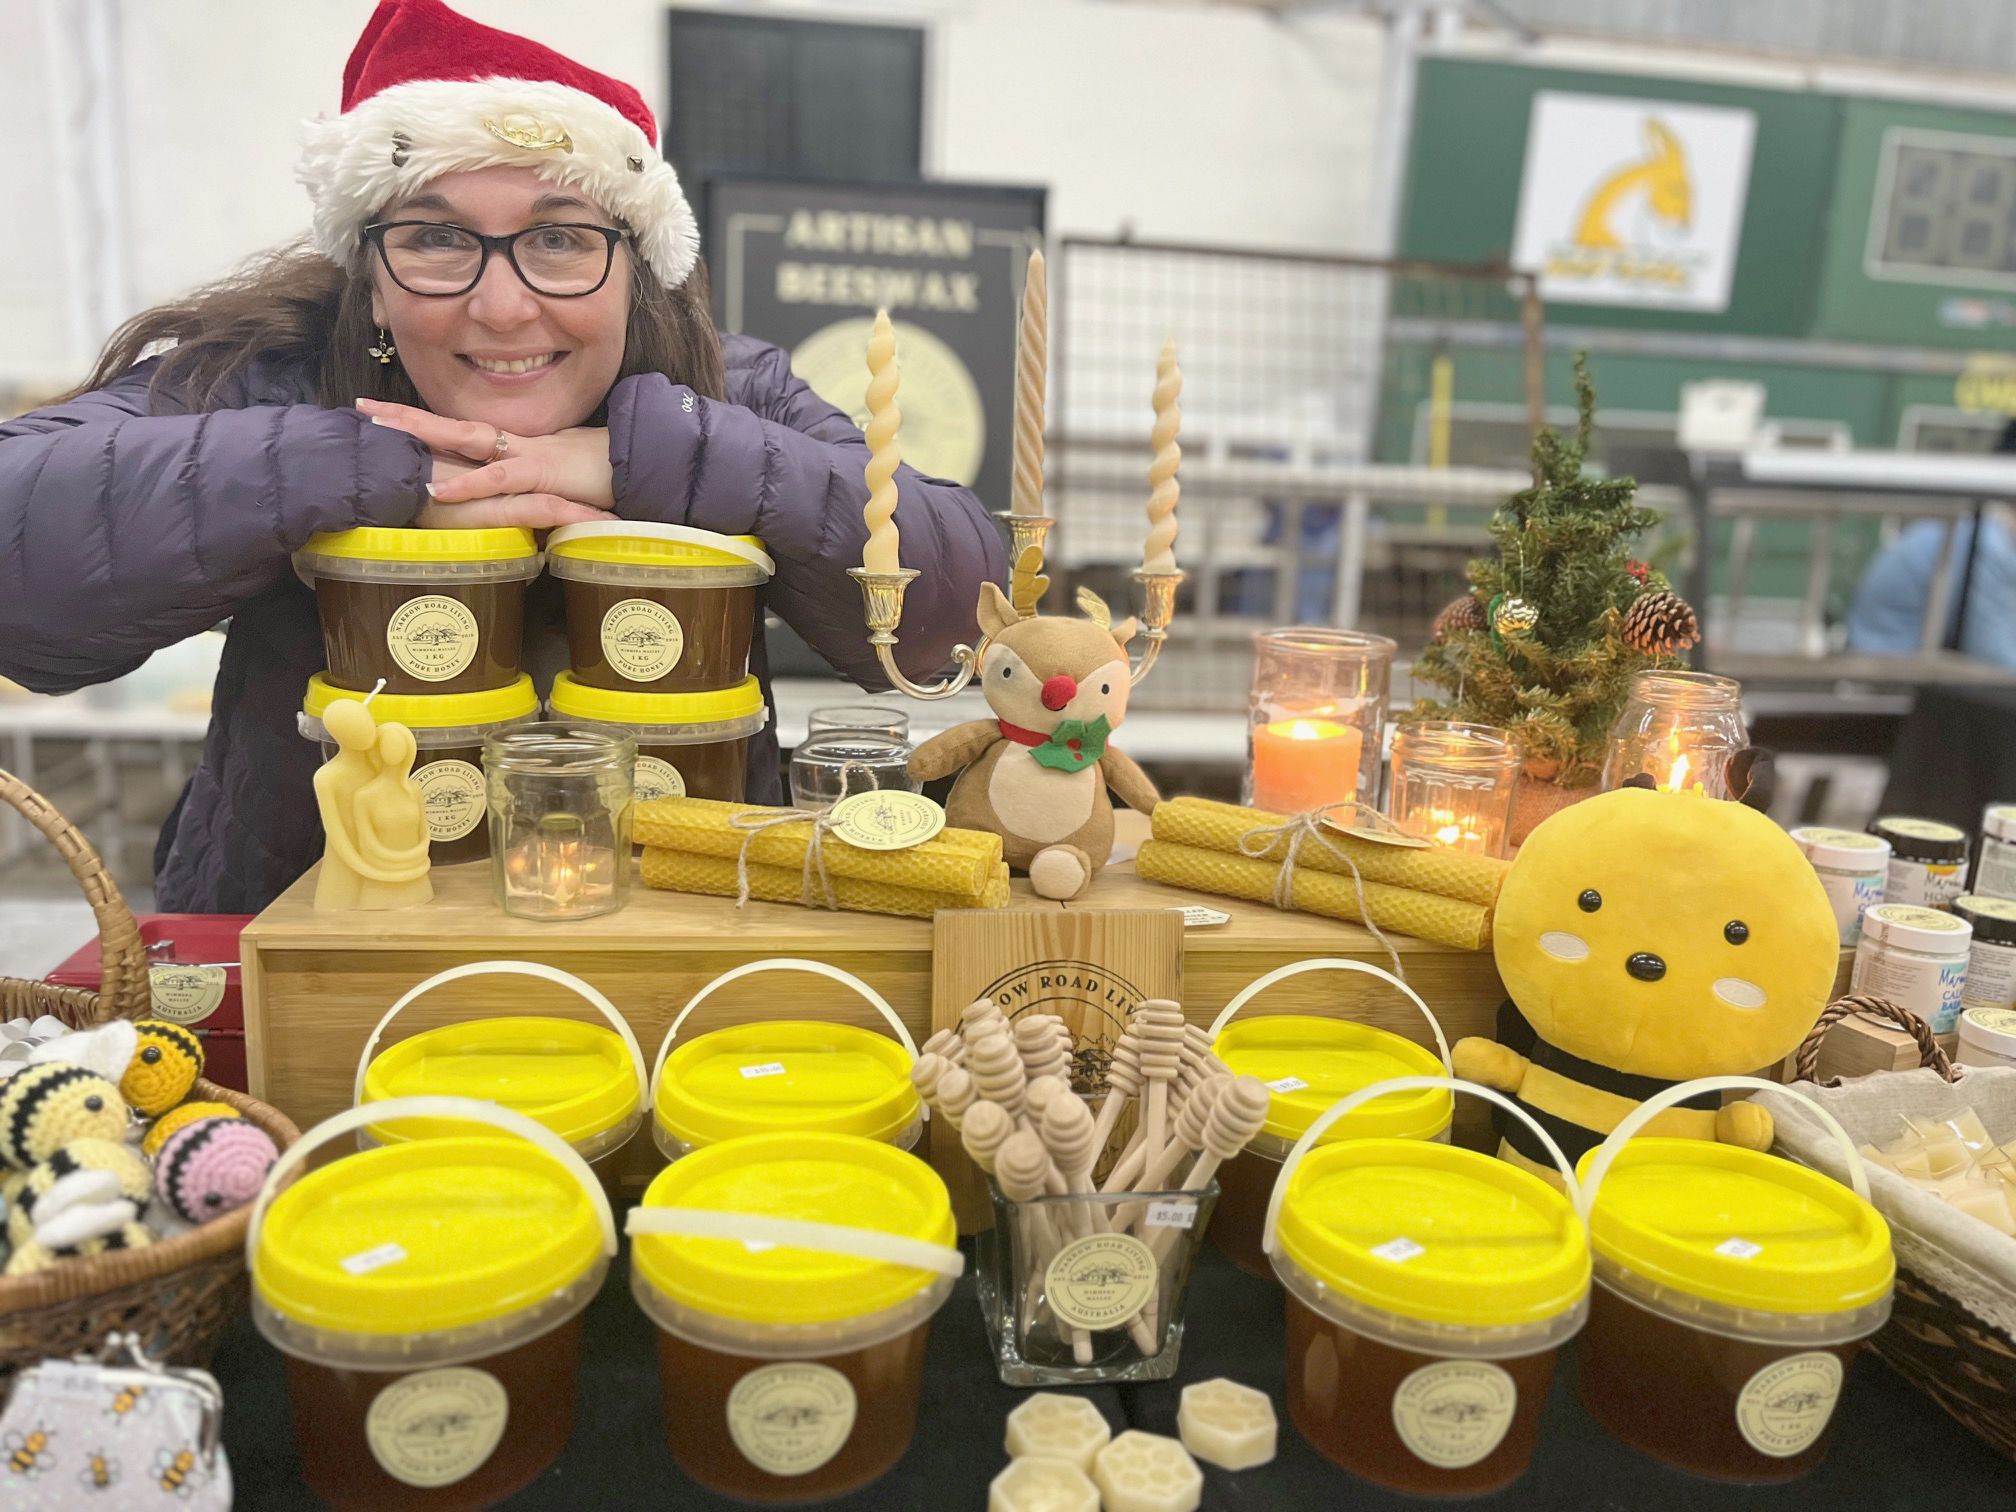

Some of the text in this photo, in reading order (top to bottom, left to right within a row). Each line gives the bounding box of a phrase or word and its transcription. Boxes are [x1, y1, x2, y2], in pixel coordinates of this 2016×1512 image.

[785, 209, 973, 259] ARTISAN
[777, 262, 980, 313] BEESWAX
[395, 605, 421, 631] NARROW
[449, 607, 471, 630] LIVING
[607, 606, 675, 635] NARROW ROAD LIVING
[409, 659, 461, 673] PURE HONEY
[617, 660, 664, 673] PURE HONEY
[462, 770, 480, 791] LIVING
[659, 768, 678, 790] LIVING
[446, 818, 471, 832] HONEY
[1040, 974, 1138, 1017] ROAD LIV
[157, 1005, 203, 1015] AUSTRALIA
[1156, 1211, 1183, 1222] $5.00
[1097, 1241, 1124, 1249] ROAD
[1071, 1304, 1125, 1317] AUSTRALIA
